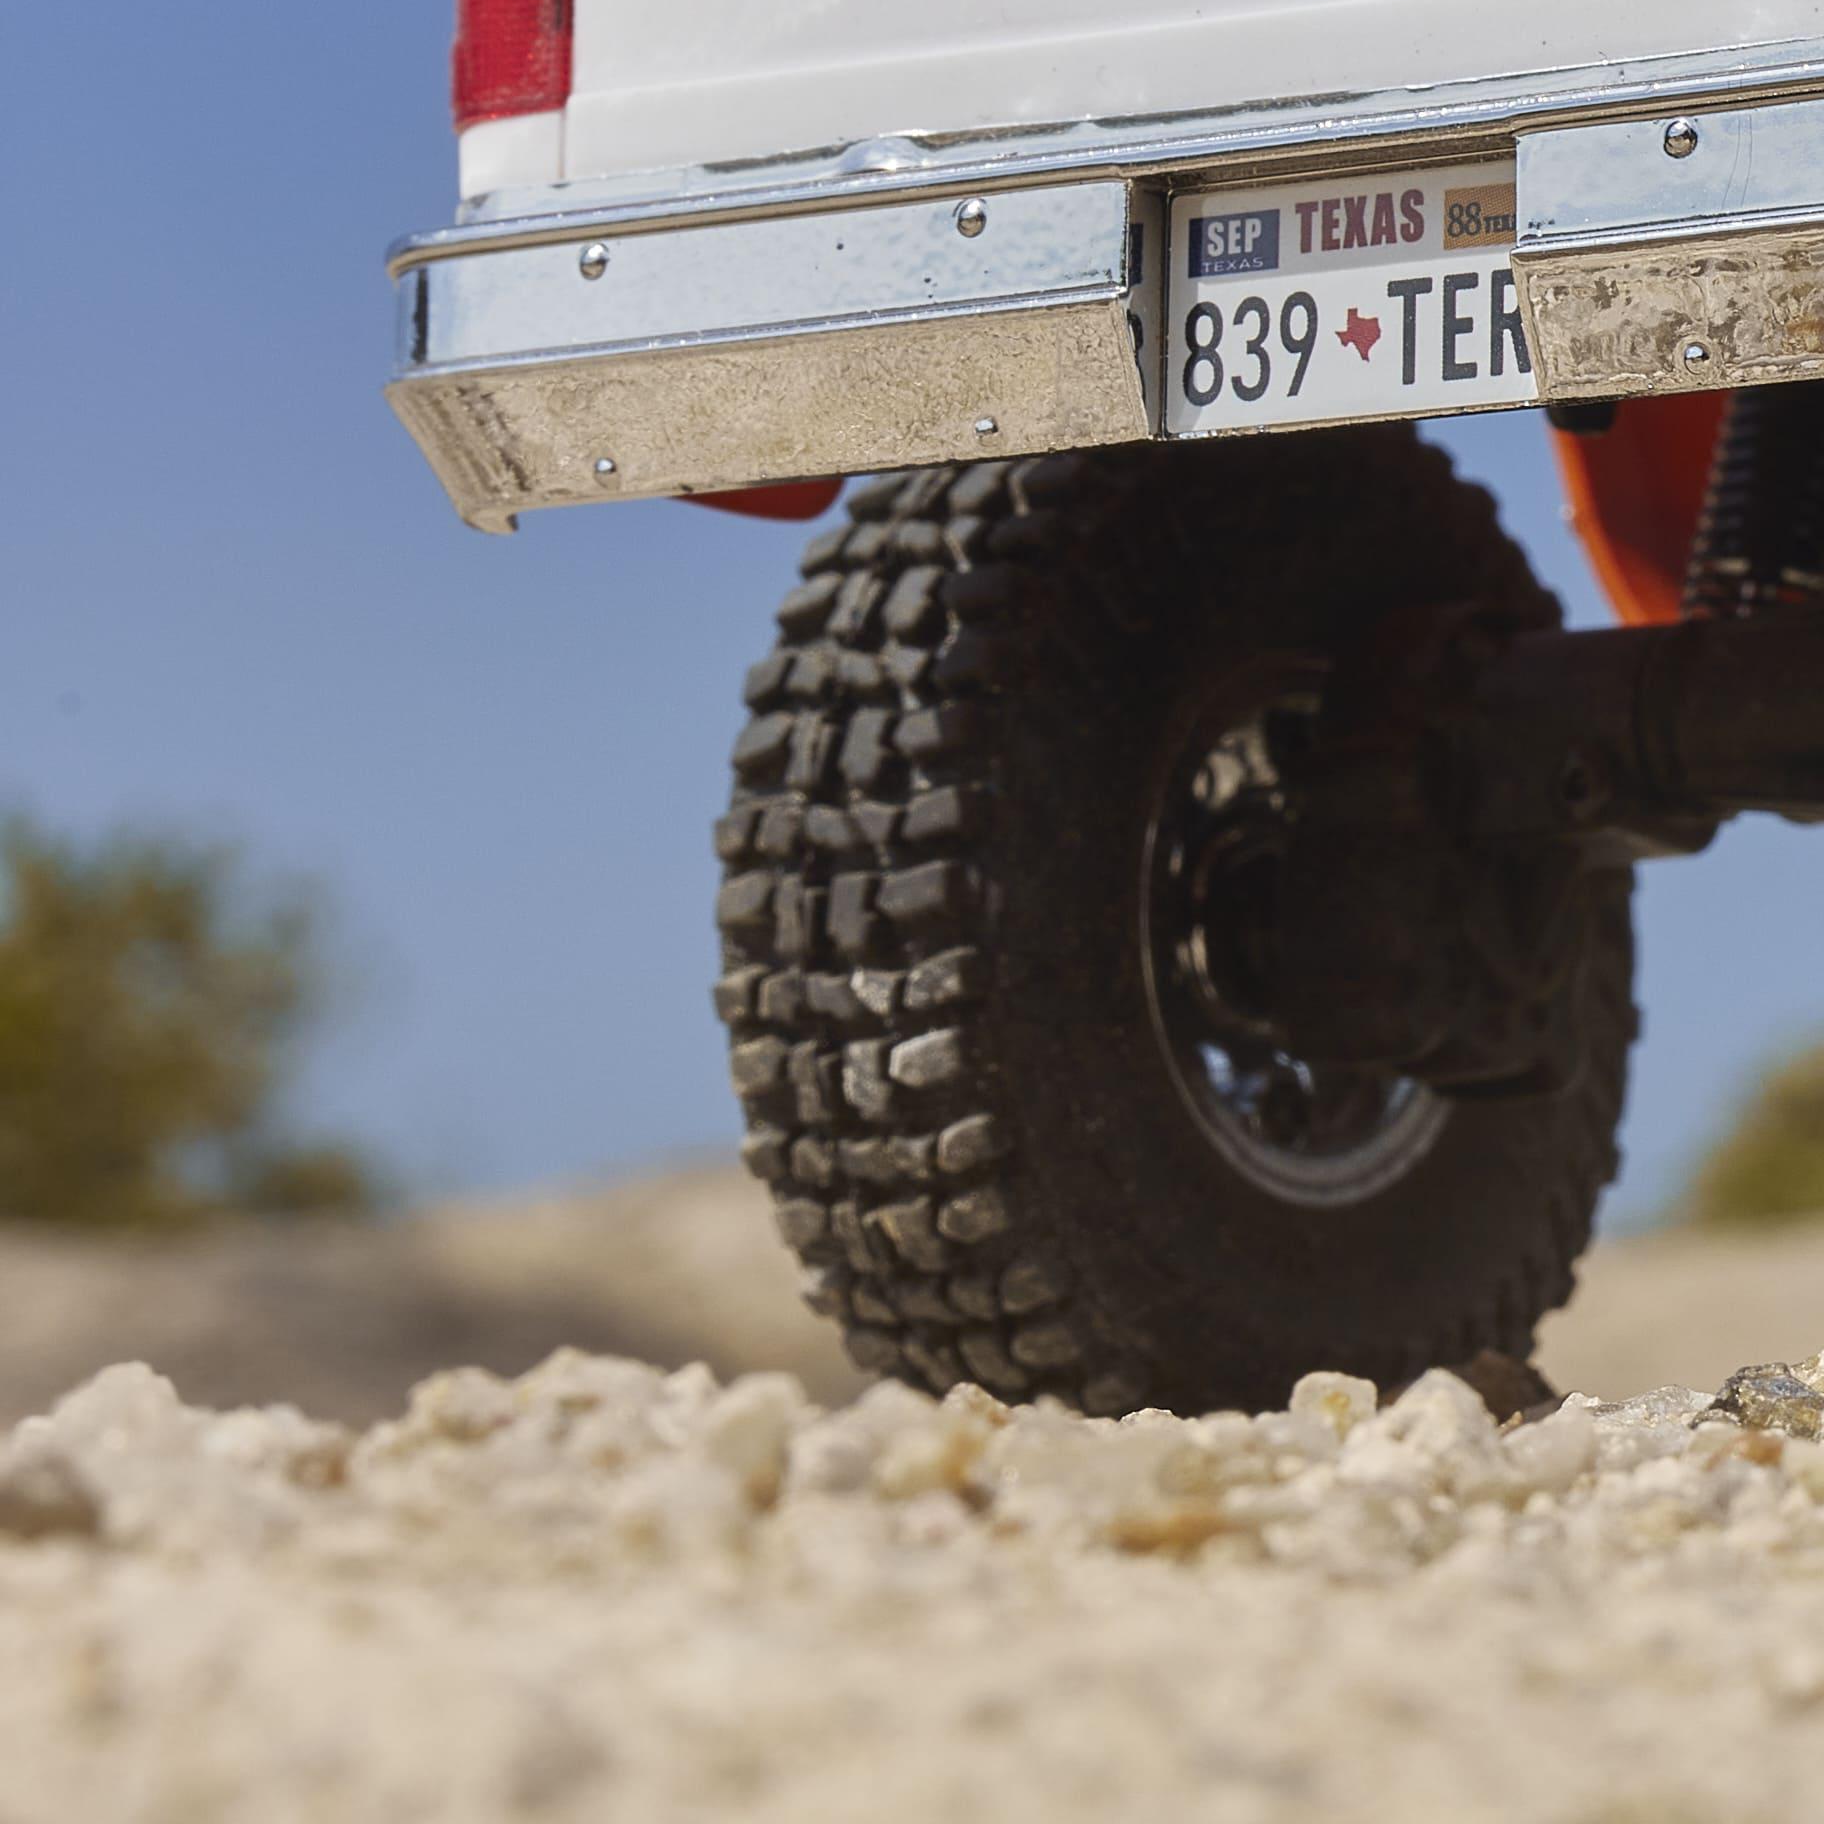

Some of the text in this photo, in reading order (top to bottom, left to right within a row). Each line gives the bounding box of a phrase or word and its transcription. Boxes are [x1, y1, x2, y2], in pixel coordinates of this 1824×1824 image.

[1207, 217, 1263, 257] SEP
[1295, 188, 1425, 254] TEXAS
[1447, 201, 1483, 237] 88
[1202, 256, 1264, 274] TEXAS
[1183, 268, 1533, 407] 839 TER
